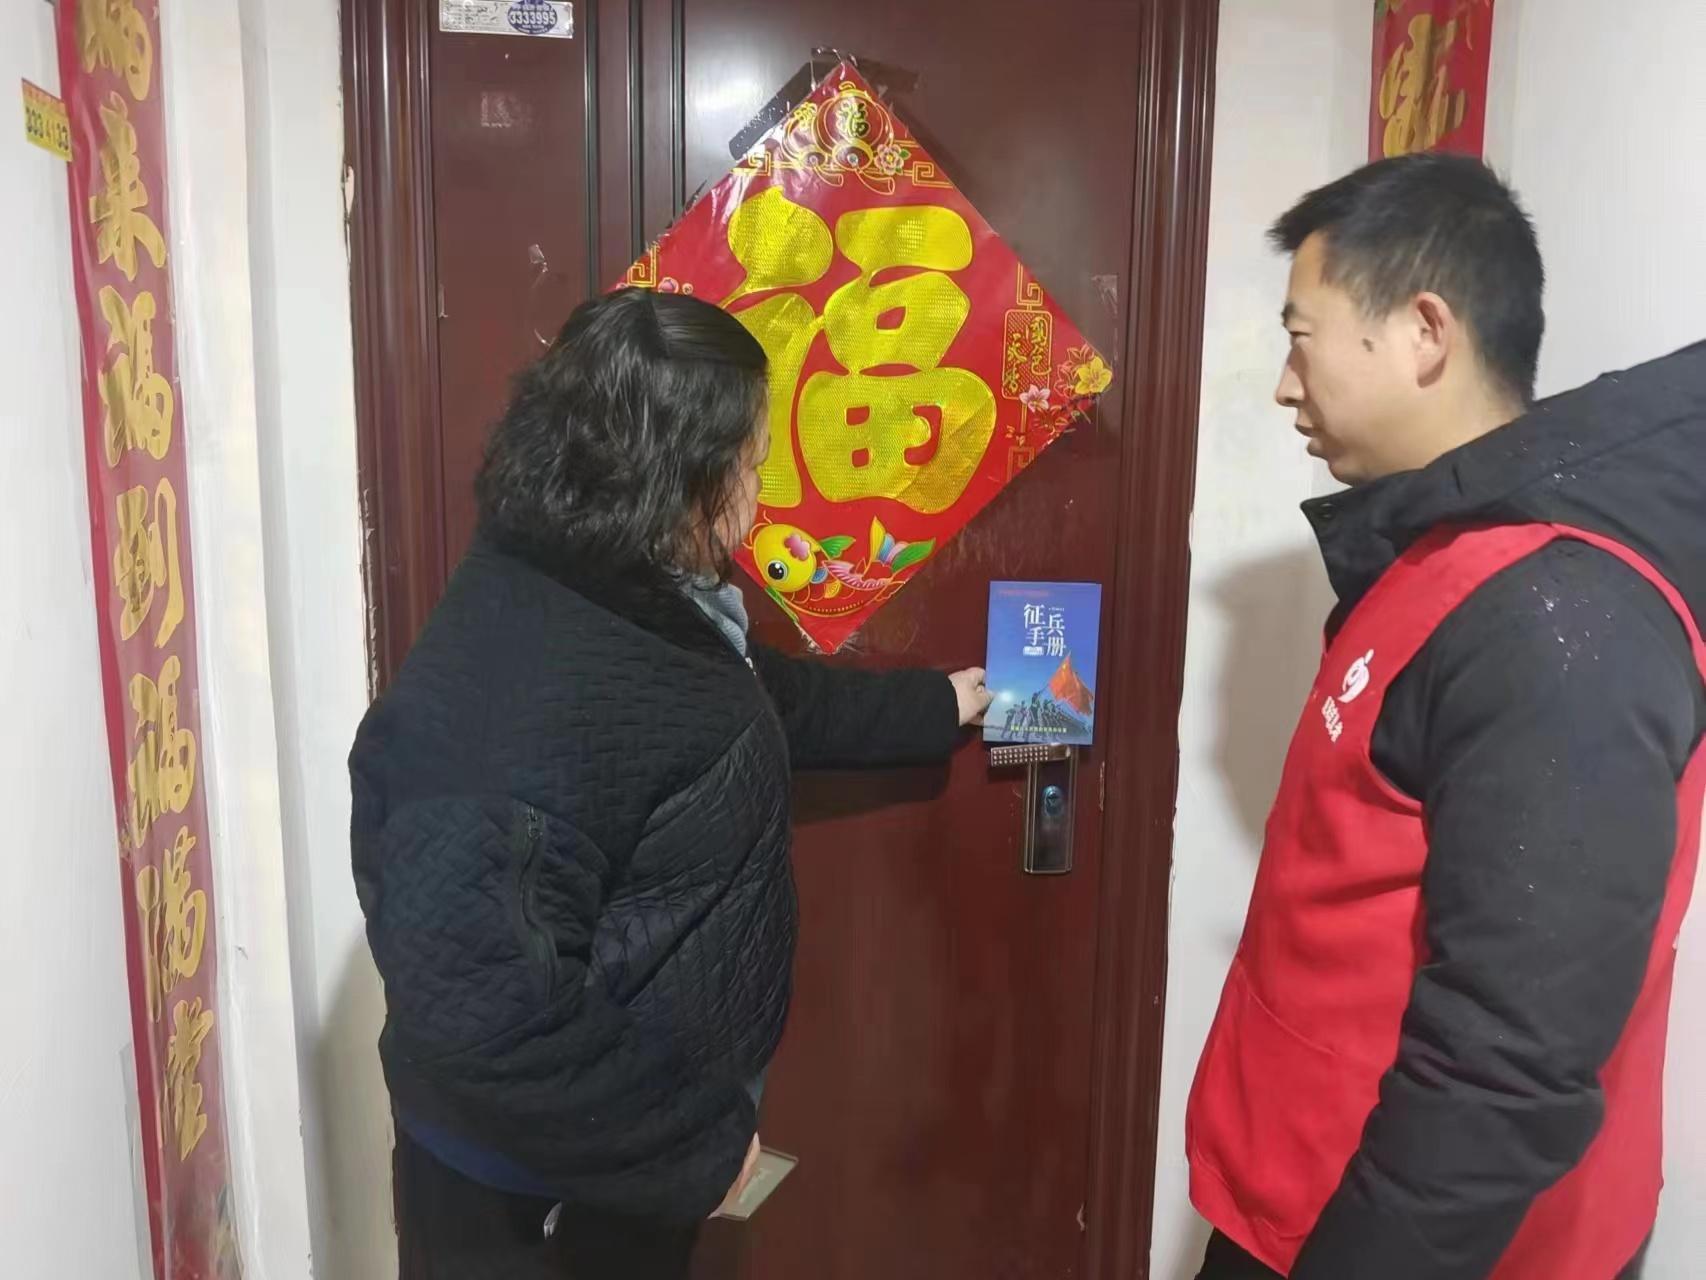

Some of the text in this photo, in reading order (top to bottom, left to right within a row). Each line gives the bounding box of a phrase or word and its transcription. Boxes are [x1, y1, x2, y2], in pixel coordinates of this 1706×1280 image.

[509, 10, 557, 25] 3333995
[835, 98, 872, 138] 福
[722, 185, 997, 514] 福
